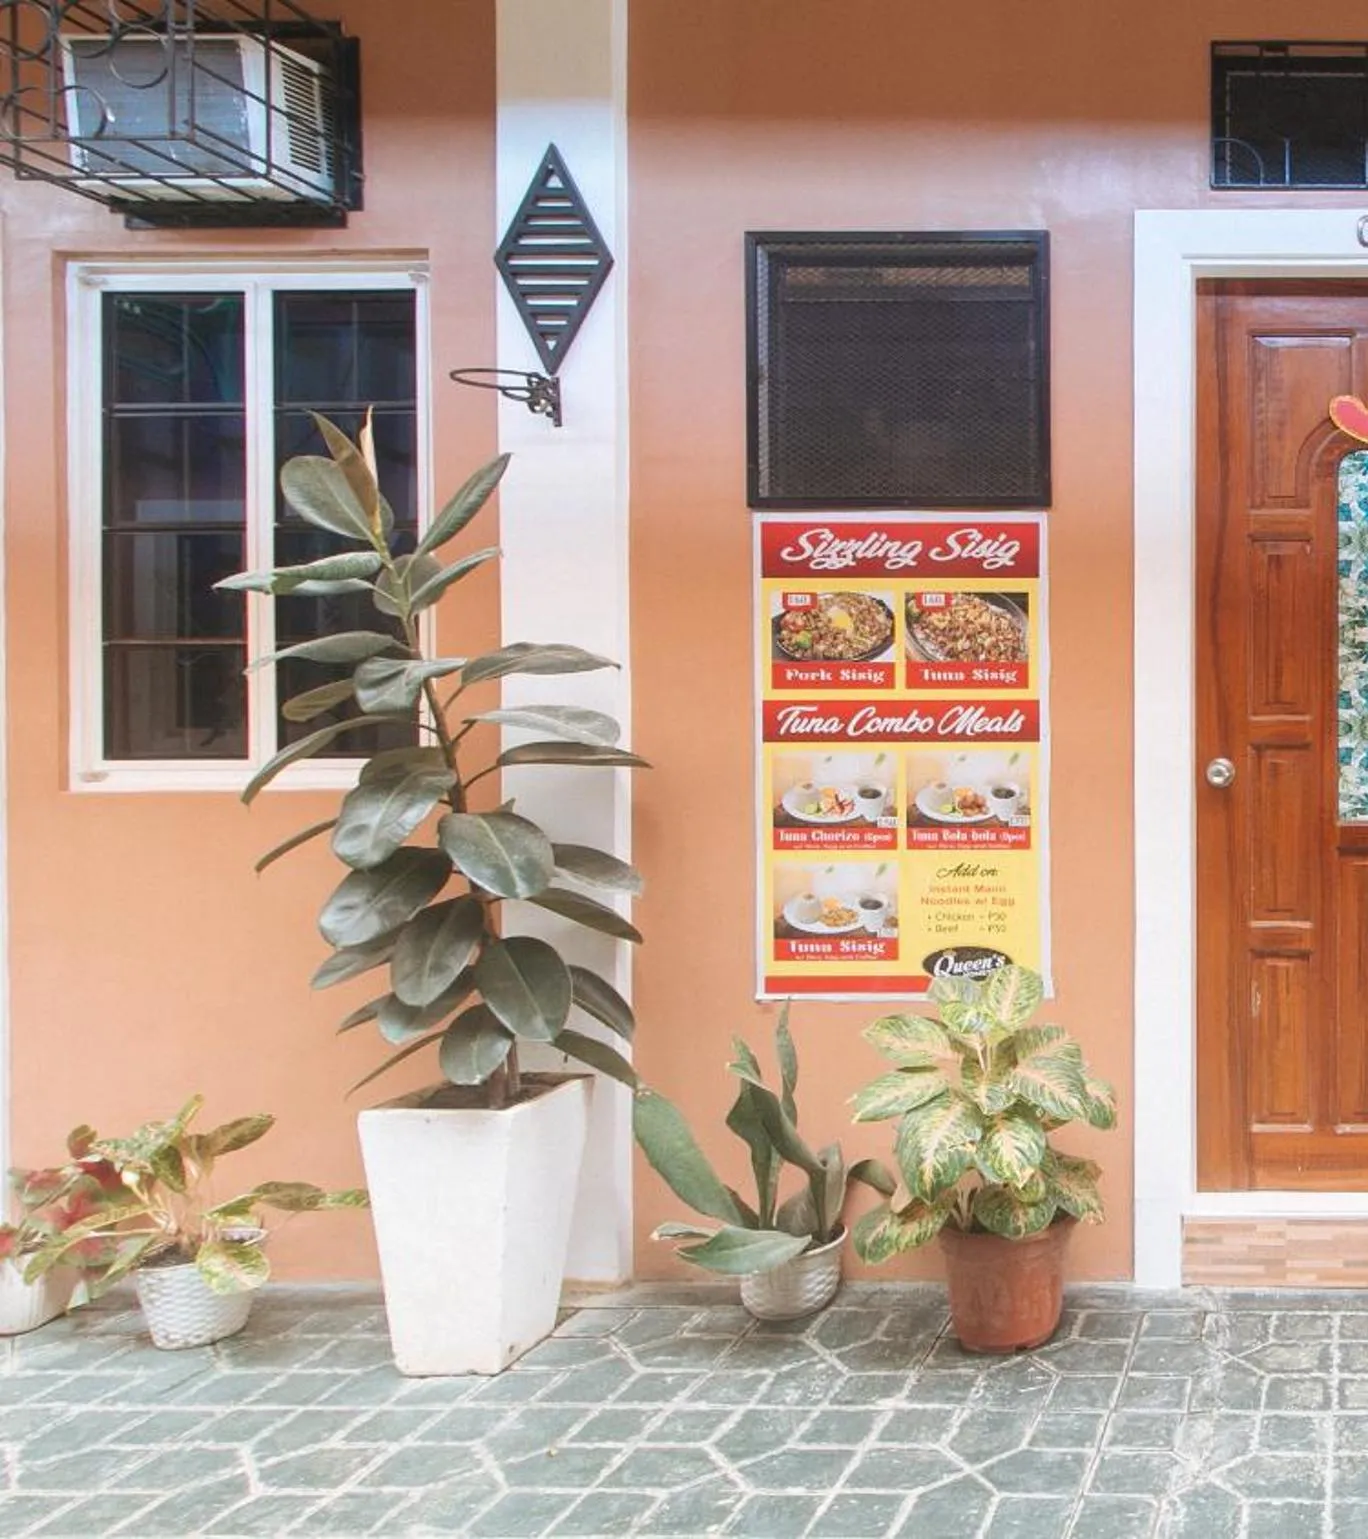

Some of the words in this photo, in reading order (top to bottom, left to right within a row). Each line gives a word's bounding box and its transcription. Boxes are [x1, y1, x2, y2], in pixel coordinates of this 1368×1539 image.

[780, 528, 923, 570] Sizzling
[928, 528, 1021, 570] Sisig
[785, 668, 832, 682] Pork
[839, 668, 885, 684] Sisig
[921, 668, 965, 681] Tuna
[971, 668, 1018, 684] Sisig
[776, 704, 845, 736] Tuna
[846, 705, 935, 738] Combo
[937, 704, 1026, 737] Meals
[789, 941, 833, 953] Tuna
[933, 953, 1006, 978] Queen's
